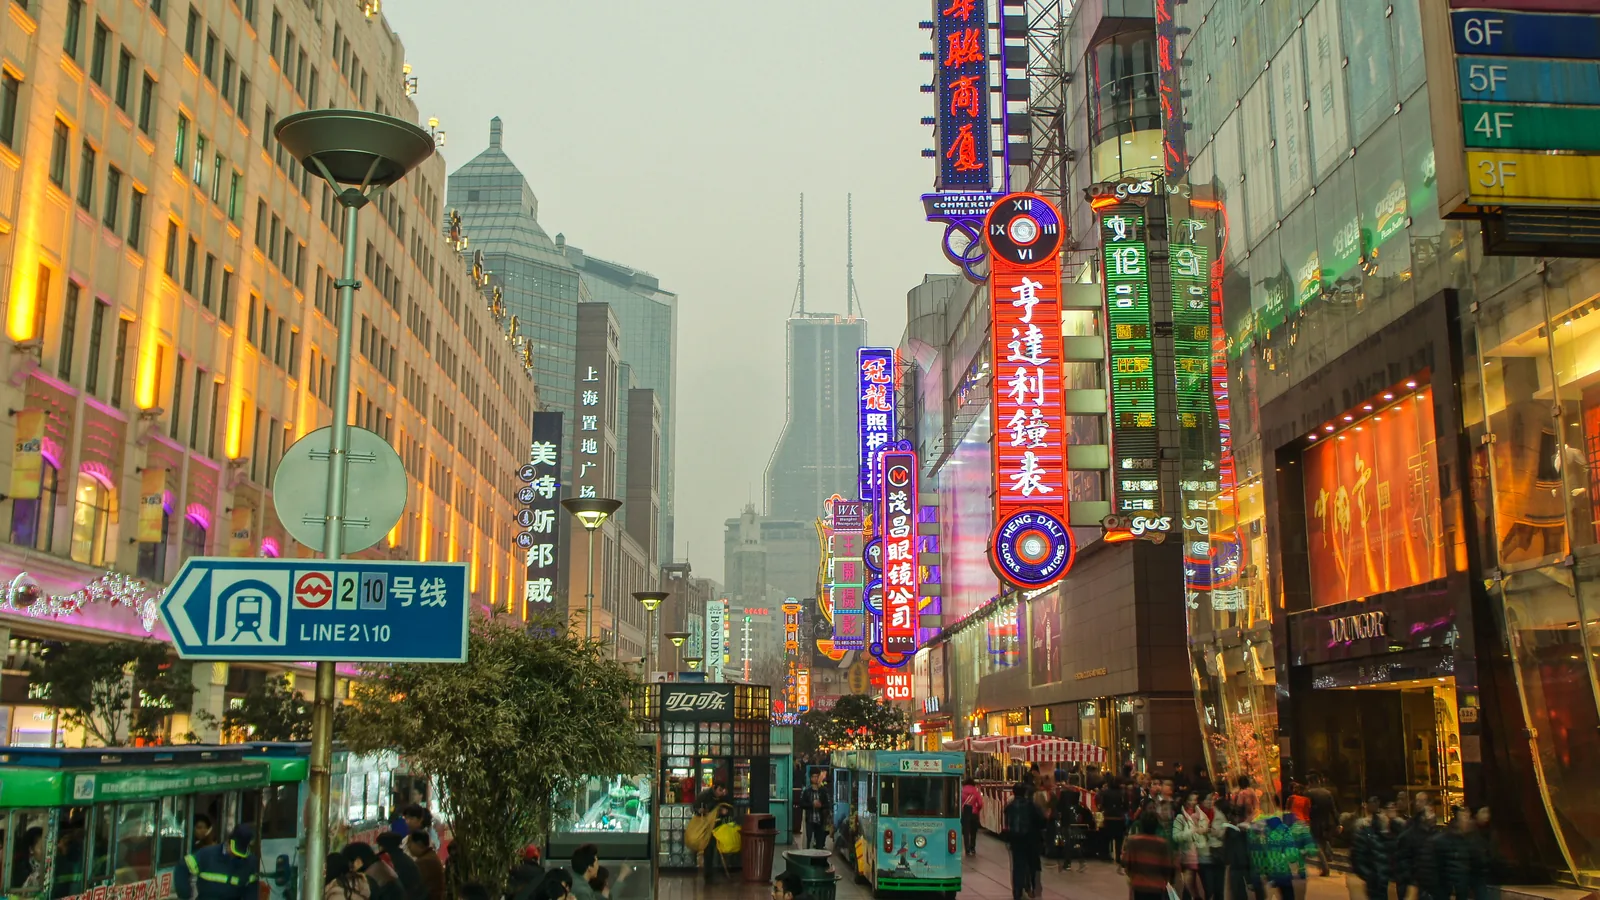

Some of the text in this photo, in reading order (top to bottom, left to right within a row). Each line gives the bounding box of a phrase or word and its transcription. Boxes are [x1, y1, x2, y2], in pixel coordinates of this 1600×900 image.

[1464, 18, 1503, 45] 6F
[1469, 65, 1507, 92] 5F
[1473, 111, 1514, 139] 4F
[1478, 160, 1517, 188] 3F
[933, 201, 995, 209] COMMERCIA
[1013, 199, 1032, 211] XII
[579, 366, 599, 498] 上海置地广场
[526, 441, 557, 602] 美特斯邦威
[1003, 515, 1062, 538] HENG DALI
[887, 491, 914, 629] 茂昌眼镜公司
[1001, 543, 1065, 576] CLOCKS WATCHES
[342, 576, 447, 608] 2 10 号线
[300, 624, 345, 642] LINE
[887, 676, 907, 687] UNI
[887, 687, 909, 699] QLO
[665, 690, 729, 711] 可口可乐
